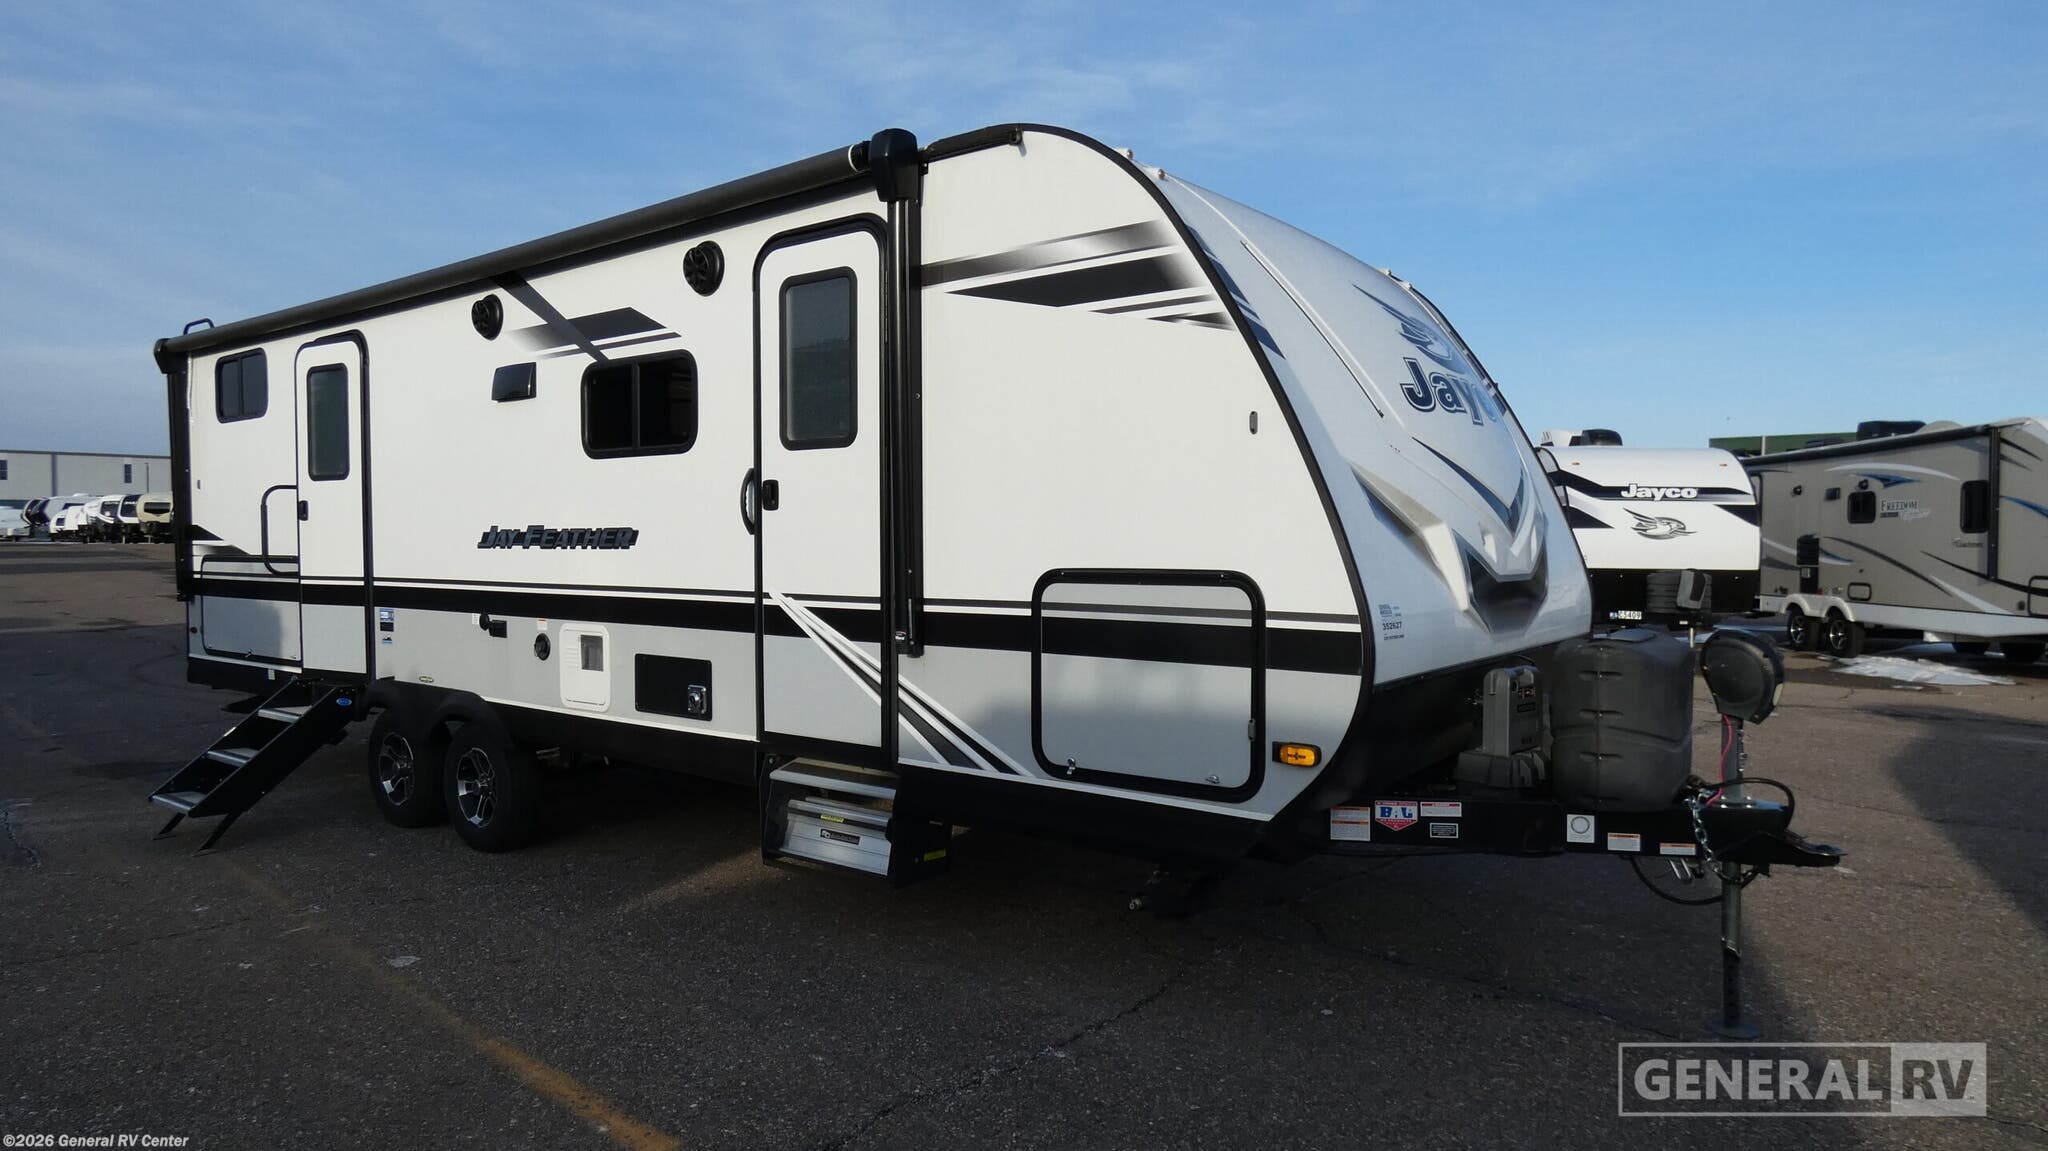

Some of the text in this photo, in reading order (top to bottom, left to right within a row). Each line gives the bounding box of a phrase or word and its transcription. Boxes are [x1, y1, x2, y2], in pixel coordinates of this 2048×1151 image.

[1620, 483, 1698, 502] Jayco
[477, 525, 639, 549] JAY FEATHER
